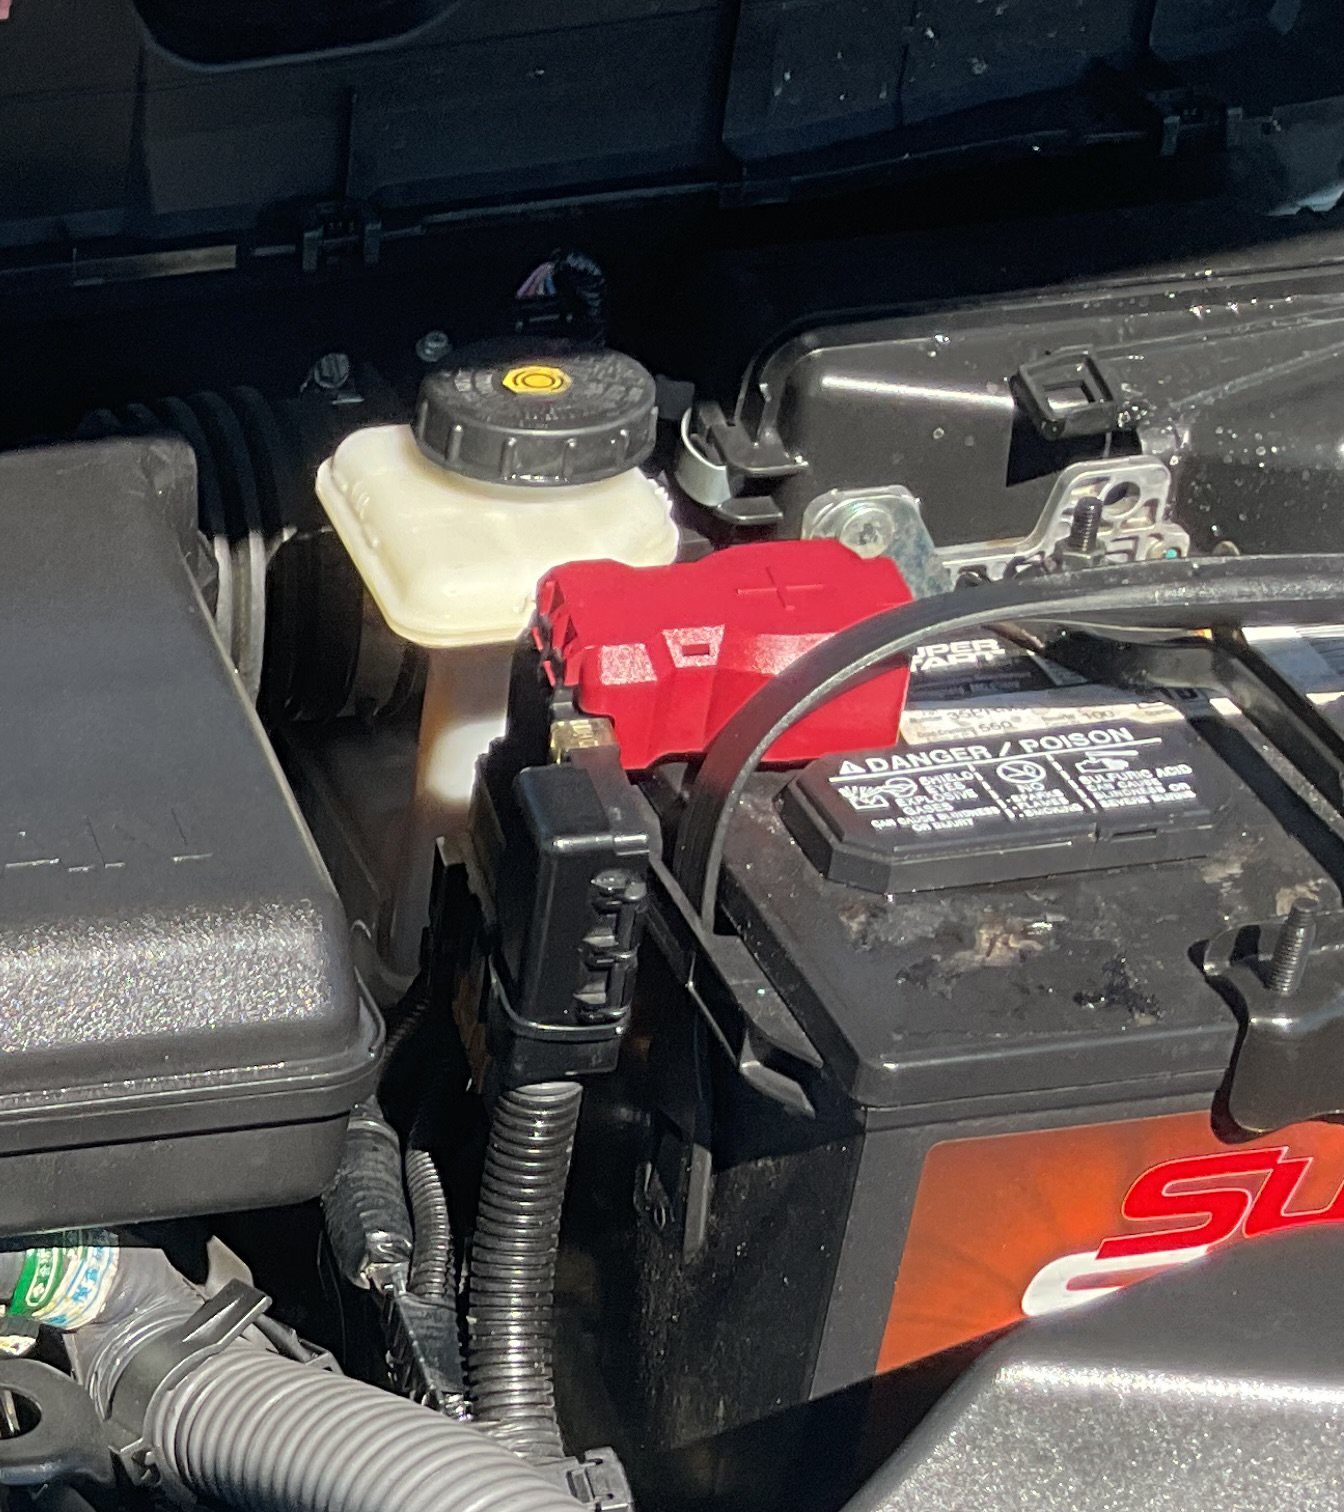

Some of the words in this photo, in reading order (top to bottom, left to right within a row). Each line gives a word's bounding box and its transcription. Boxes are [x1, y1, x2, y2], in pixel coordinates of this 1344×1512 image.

[912, 639, 999, 656] UPER
[911, 649, 1005, 672] TART
[865, 744, 995, 773] DANGER
[1019, 727, 1134, 752] POISON
[1156, 764, 1192, 777] ACID
